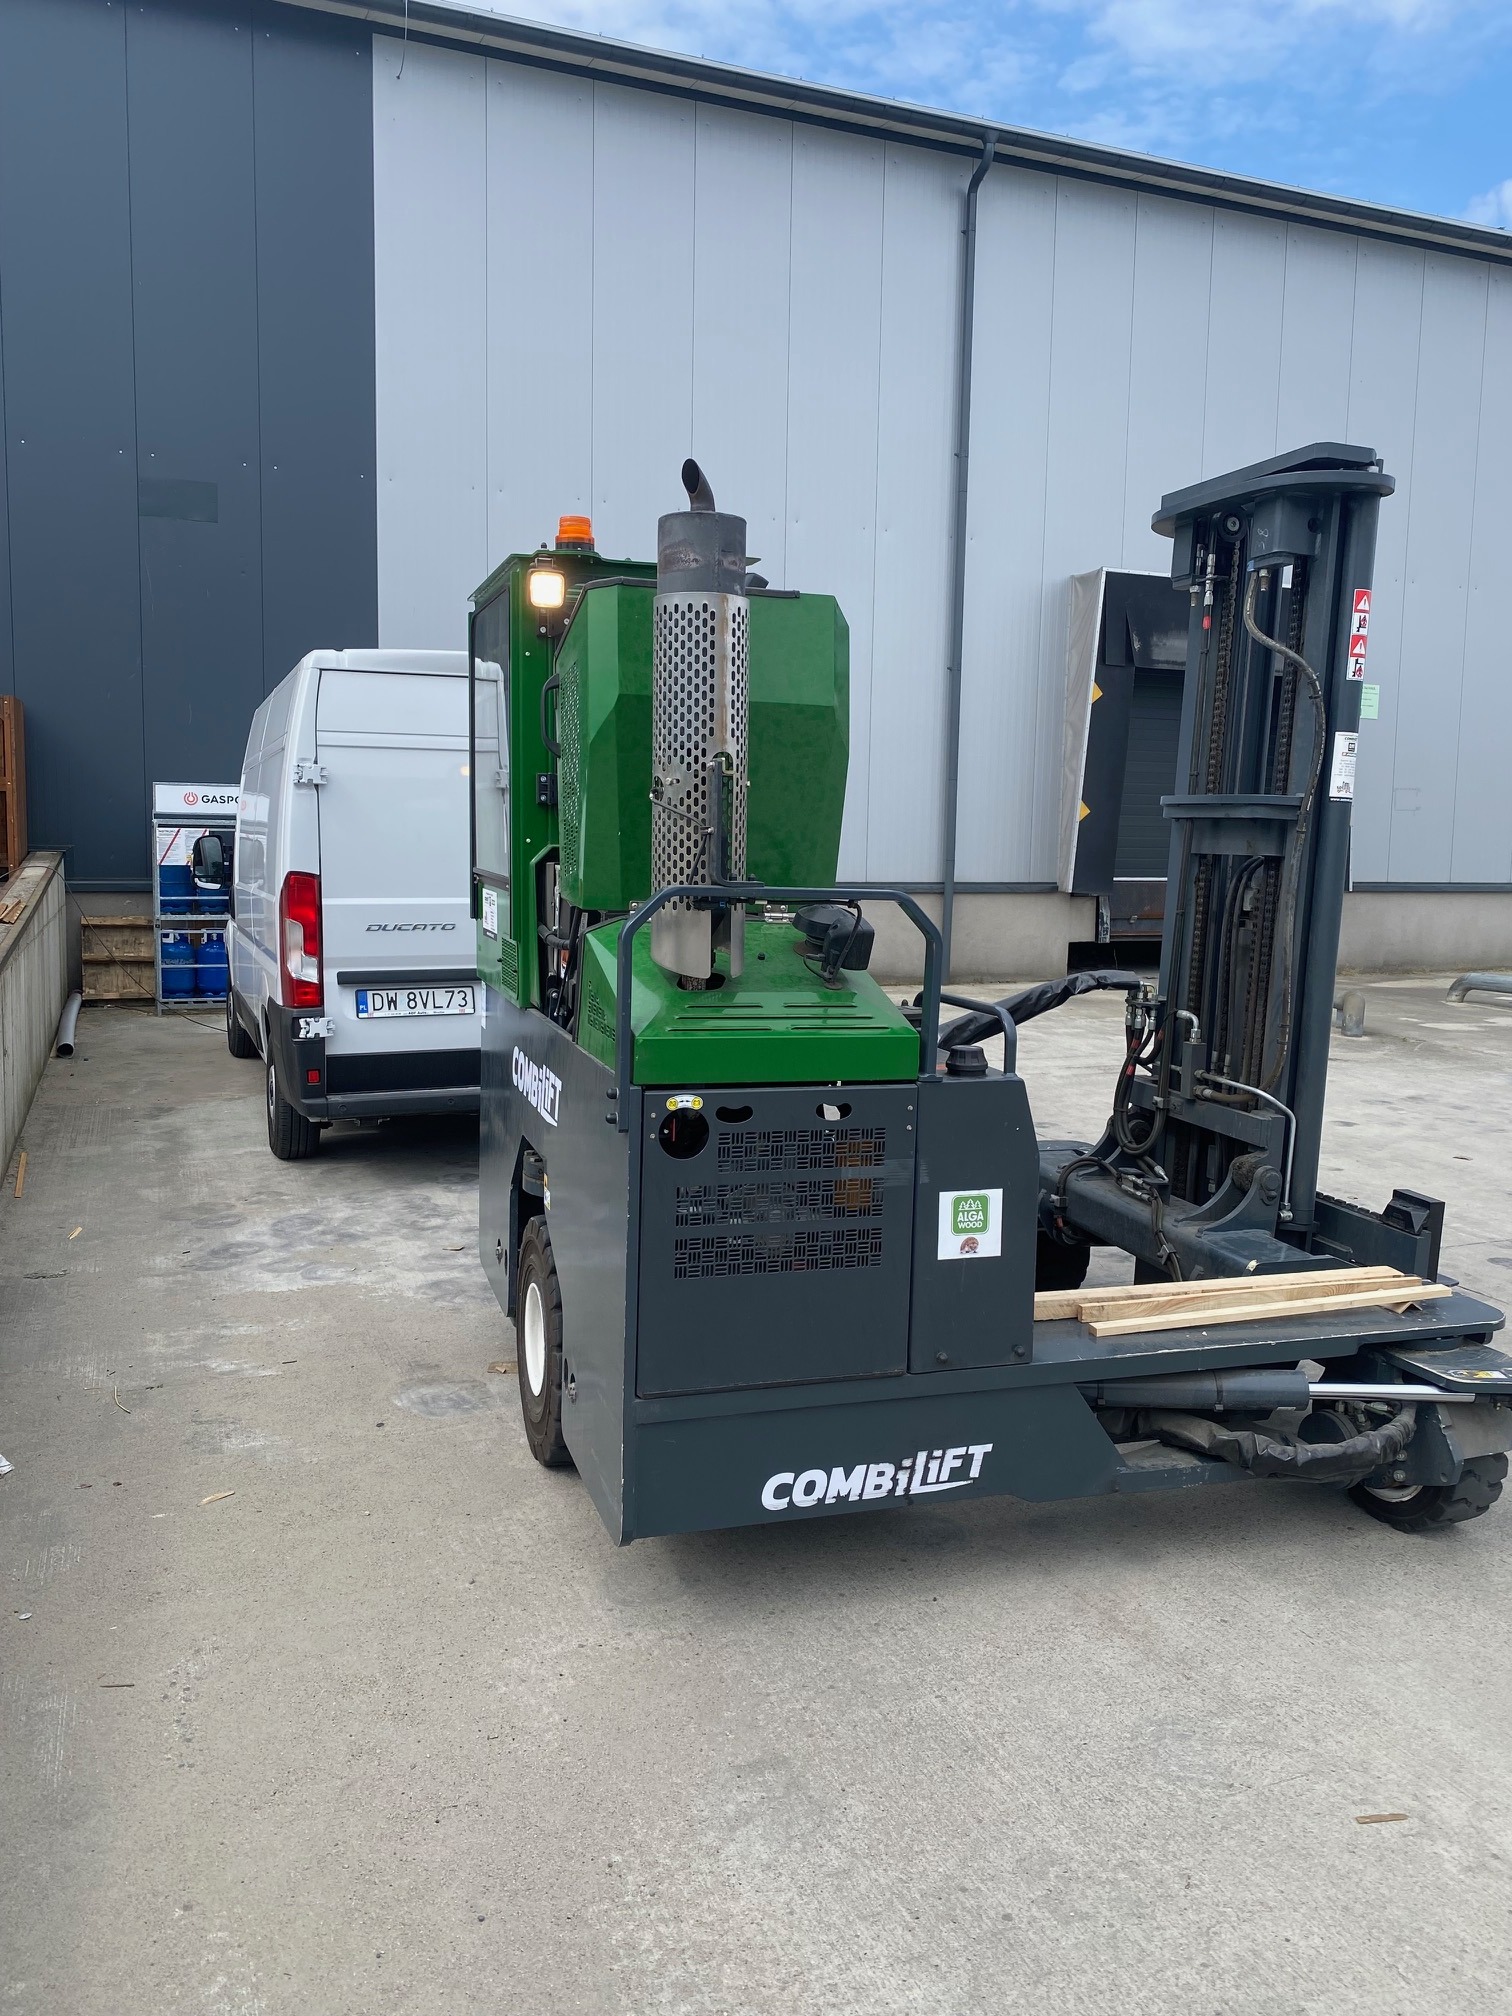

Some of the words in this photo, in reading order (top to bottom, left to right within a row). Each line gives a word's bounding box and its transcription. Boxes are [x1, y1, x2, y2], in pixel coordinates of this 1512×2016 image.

[365, 923, 456, 931] DUCATO
[372, 992, 398, 1011] DW
[406, 990, 468, 1009] 8VL73
[957, 1211, 984, 1222] ALGA
[958, 1221, 983, 1229] WOOD
